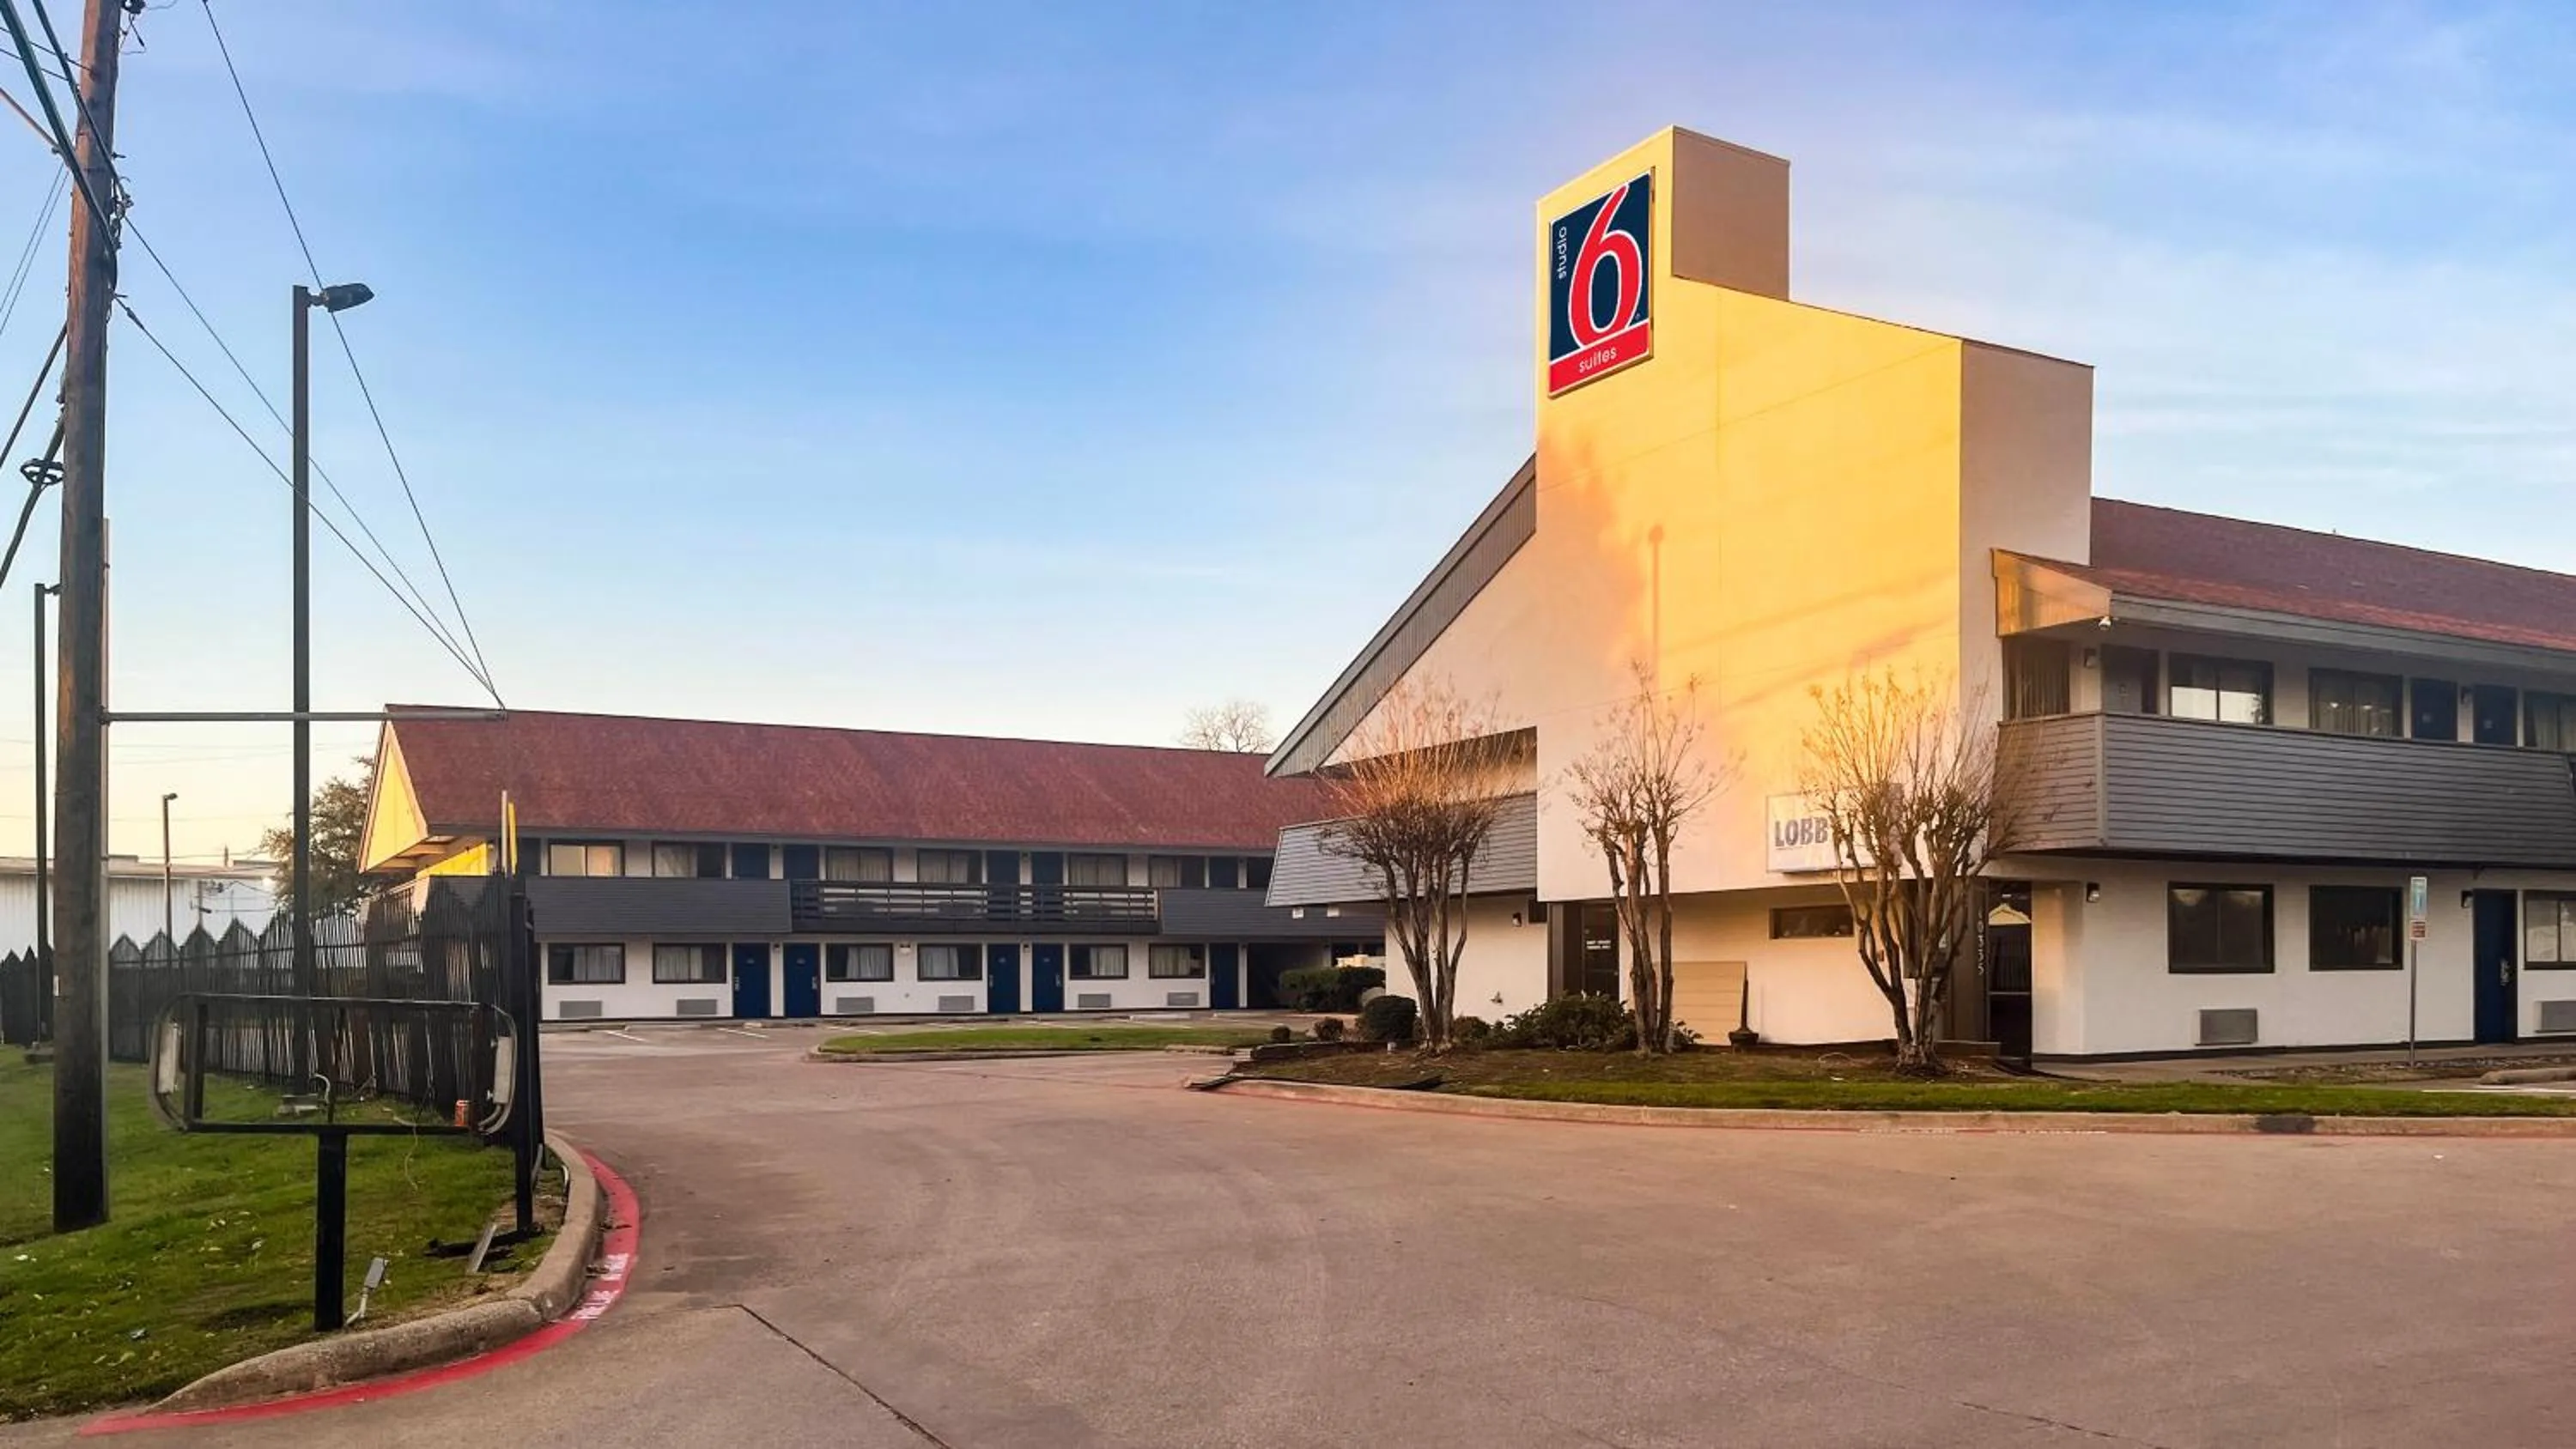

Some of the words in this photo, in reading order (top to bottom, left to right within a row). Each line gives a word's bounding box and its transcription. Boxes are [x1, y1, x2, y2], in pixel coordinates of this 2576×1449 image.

[1557, 226, 1567, 280] studio
[1568, 182, 1643, 350] 6
[1578, 346, 1618, 374] suites
[1774, 815, 1835, 847] LOBB
